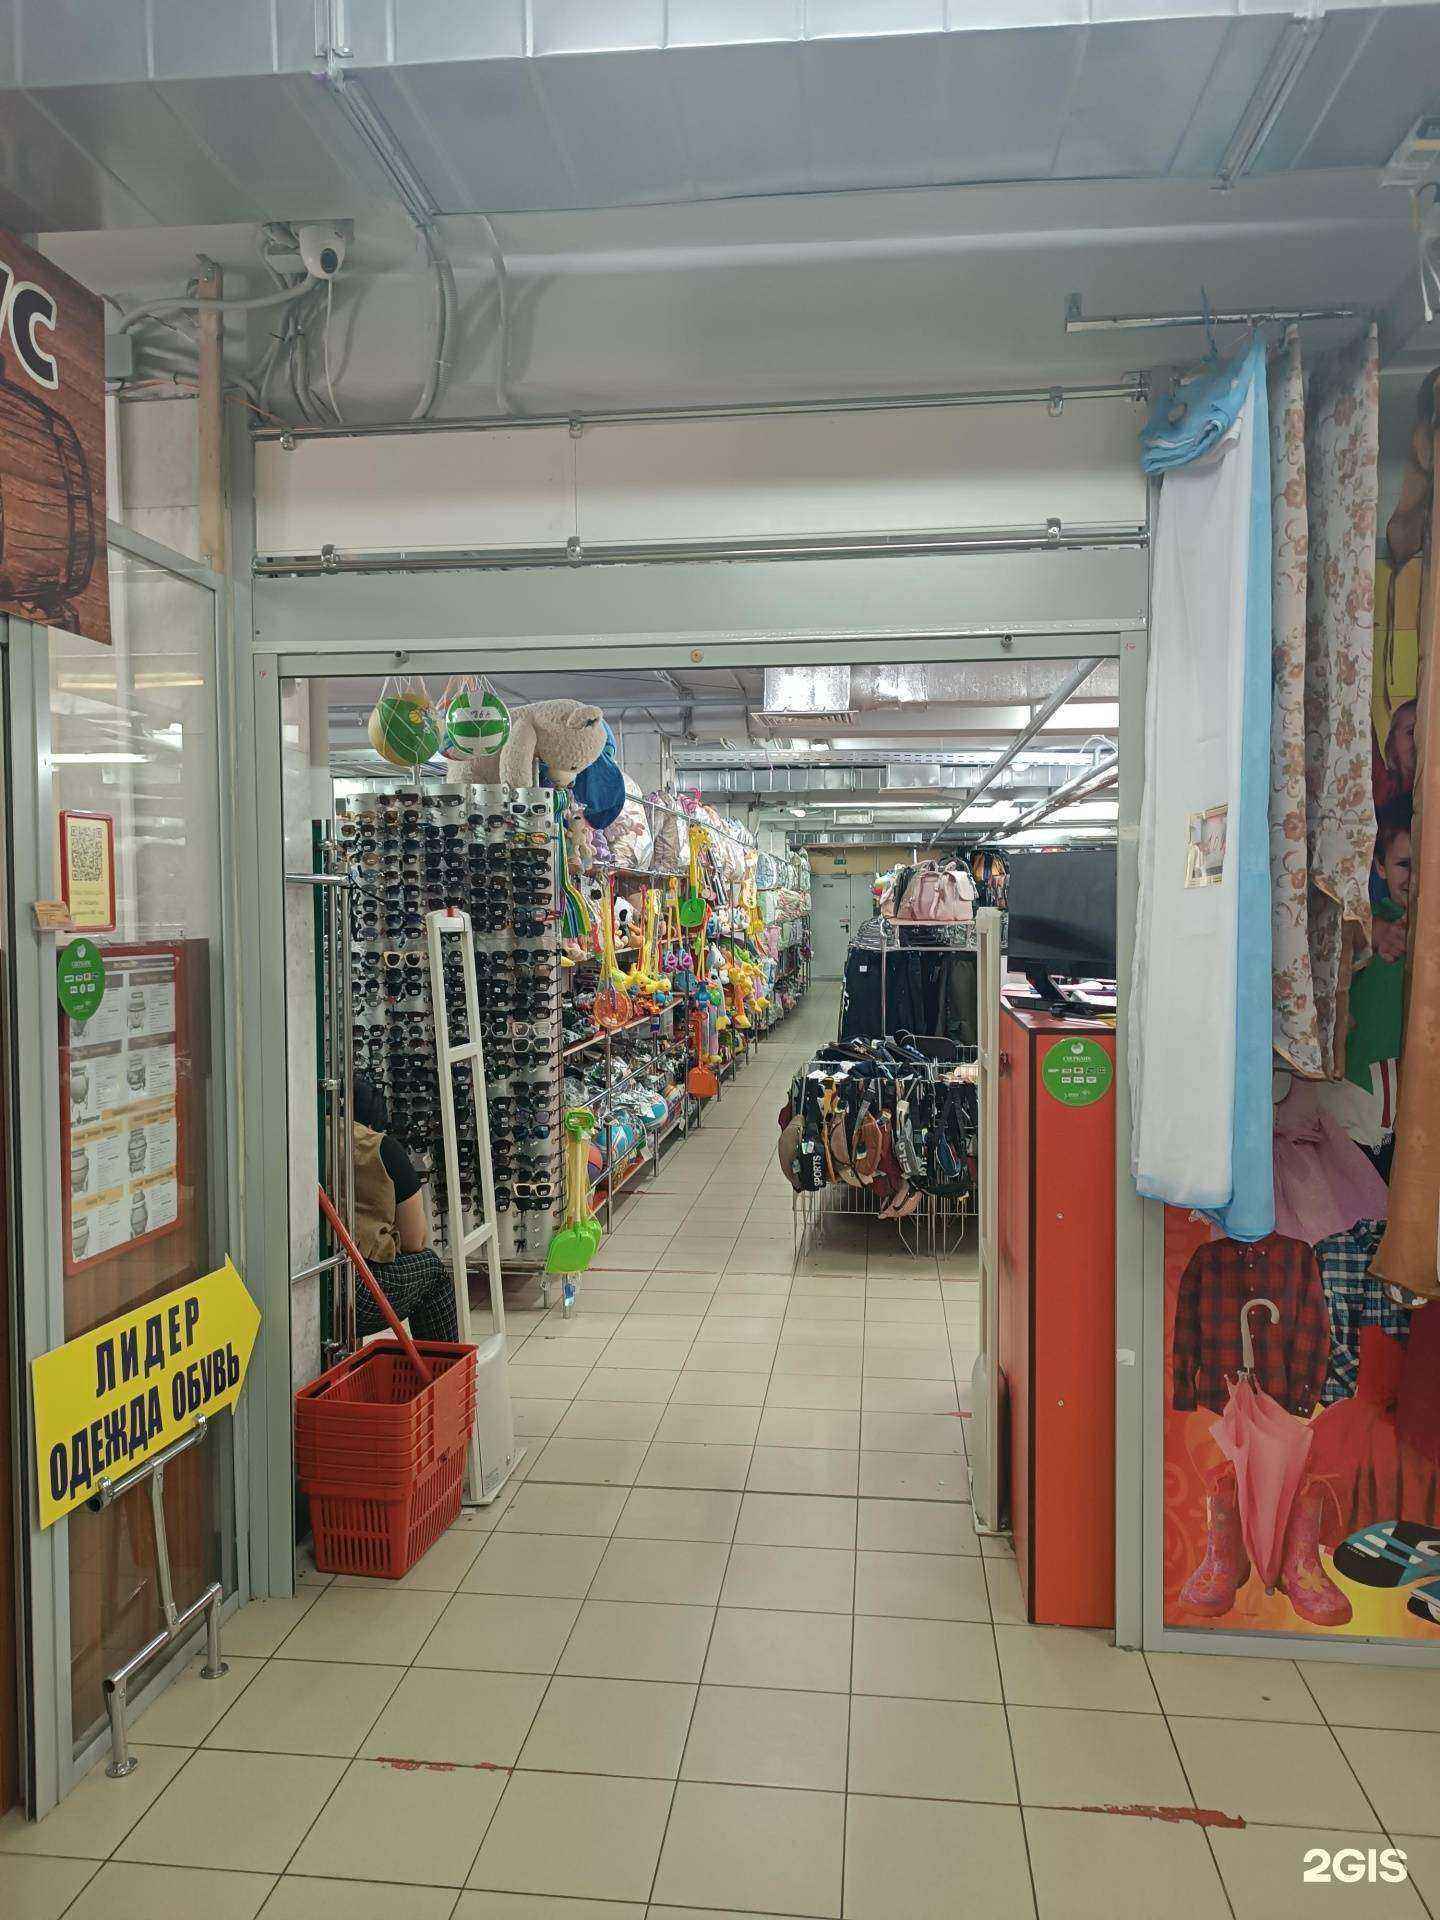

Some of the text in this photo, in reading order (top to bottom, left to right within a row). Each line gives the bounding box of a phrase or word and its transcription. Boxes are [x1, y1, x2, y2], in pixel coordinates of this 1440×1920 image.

[96, 1297, 200, 1397] ЛИДЕР
[49, 1342, 240, 1501] ОДЕЖДА ОБУВЬ
